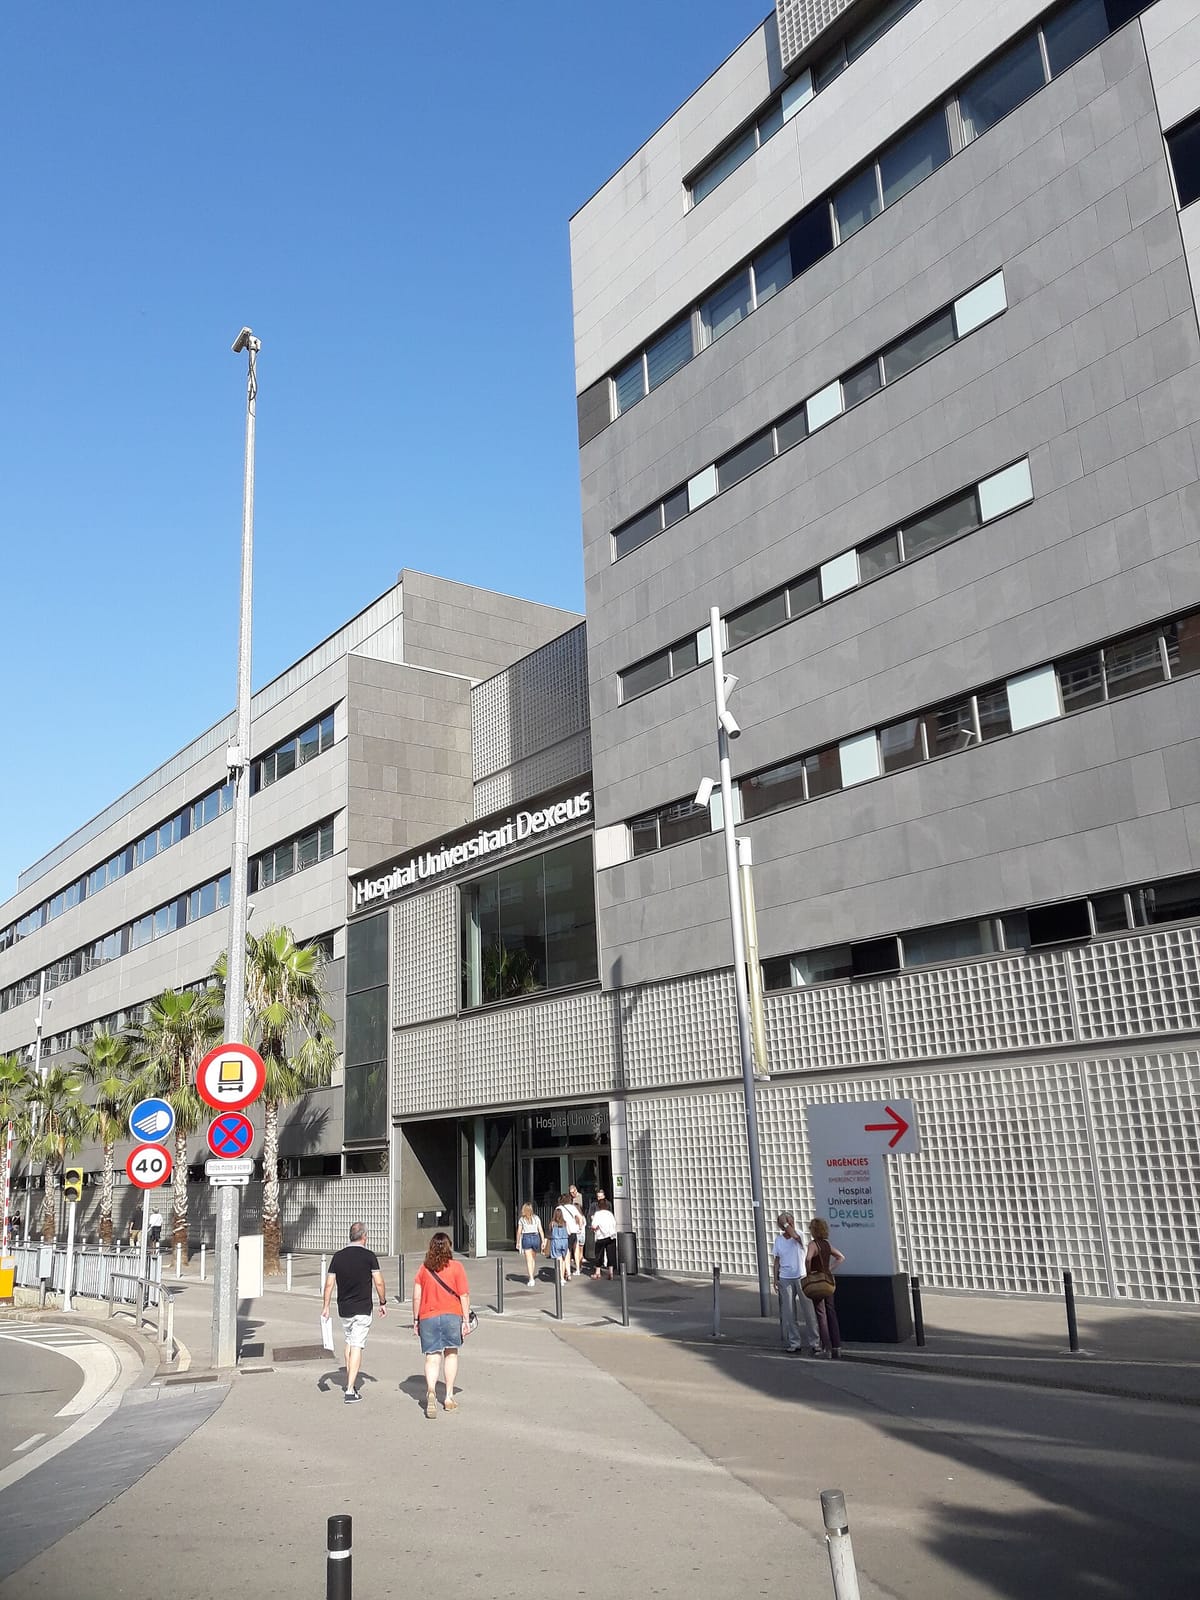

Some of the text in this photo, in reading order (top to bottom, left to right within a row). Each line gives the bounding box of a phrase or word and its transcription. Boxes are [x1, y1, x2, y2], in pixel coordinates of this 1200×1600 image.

[356, 791, 592, 904] Hospital Universitari Dexeus
[135, 1158, 163, 1173] 40
[838, 1186, 872, 1195] Hospital
[827, 1197, 873, 1206] Universitari
[828, 1207, 874, 1218] Dexeus
